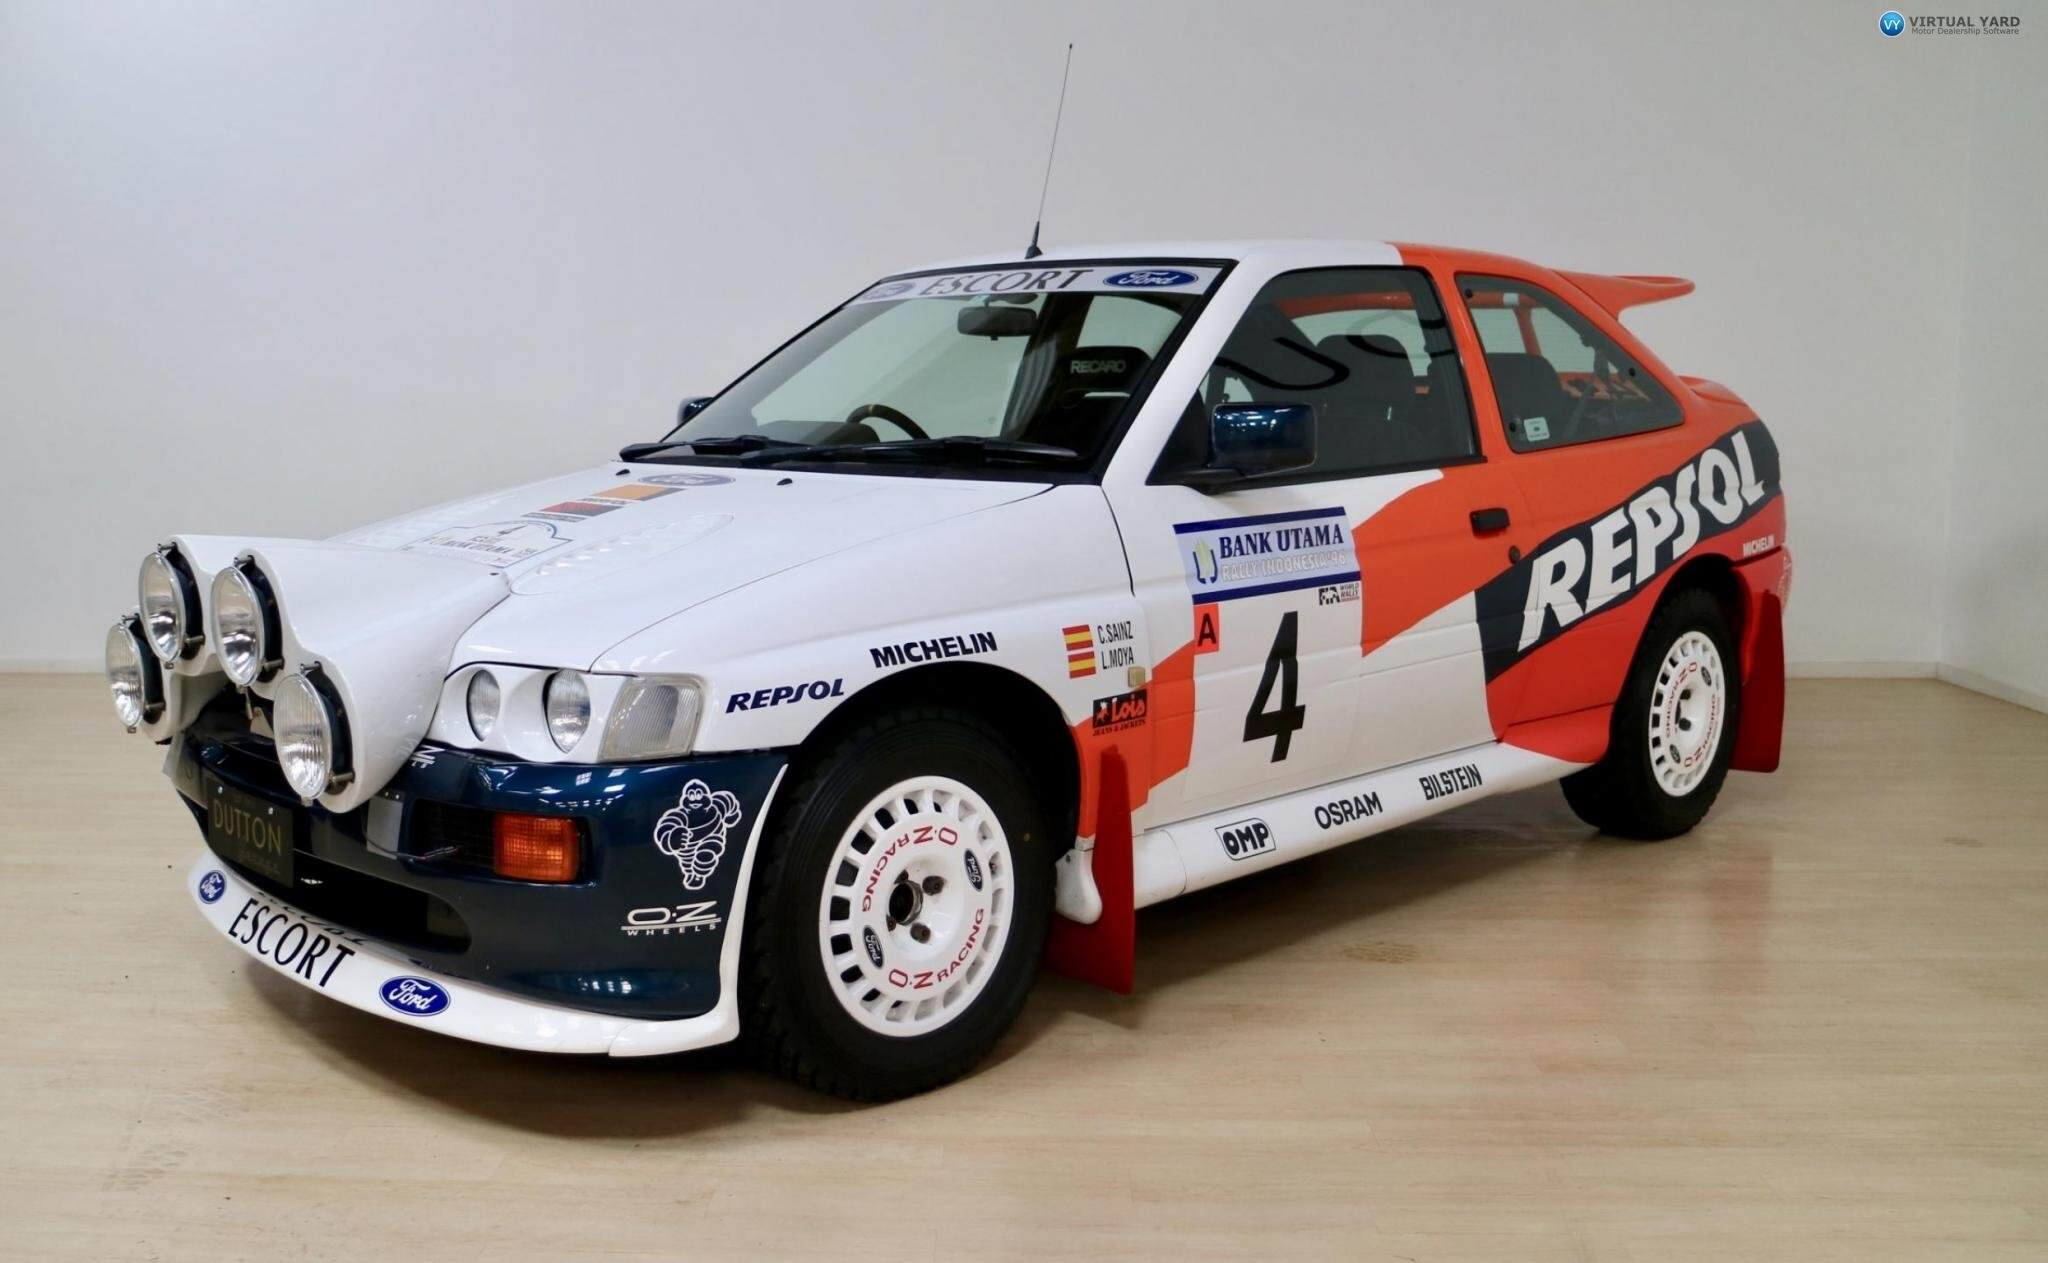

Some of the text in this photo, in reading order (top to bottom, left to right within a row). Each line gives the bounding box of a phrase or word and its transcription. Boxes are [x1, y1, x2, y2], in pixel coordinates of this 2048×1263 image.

[920, 269, 1094, 296] ESCORT
[1114, 269, 1184, 287] Ford
[1070, 360, 1127, 374] RECARO
[1219, 523, 1344, 559] BANK UTAMA
[1517, 430, 1765, 652] REPSOL
[1742, 534, 1775, 557] MICHELIN
[1221, 560, 1259, 582] RALLY
[1097, 621, 1133, 645] C.SAINZ
[1197, 612, 1217, 647] A
[869, 631, 998, 668] MICHELIN
[1101, 647, 1135, 670] L.MOYA
[725, 678, 844, 714] REPSOL
[1243, 610, 1306, 764] 4
[1110, 692, 1146, 722] Lois
[1419, 763, 1483, 800] BILSTEIN
[213, 798, 282, 856] DUTTON
[1314, 791, 1383, 829] OSRAM
[1222, 822, 1269, 855] OMP
[862, 832, 910, 913] RACING
[228, 897, 356, 987] ESCORT
[627, 924, 717, 936] WHEELS
[936, 908, 984, 983] RACING
[387, 977, 440, 1012] Ford
